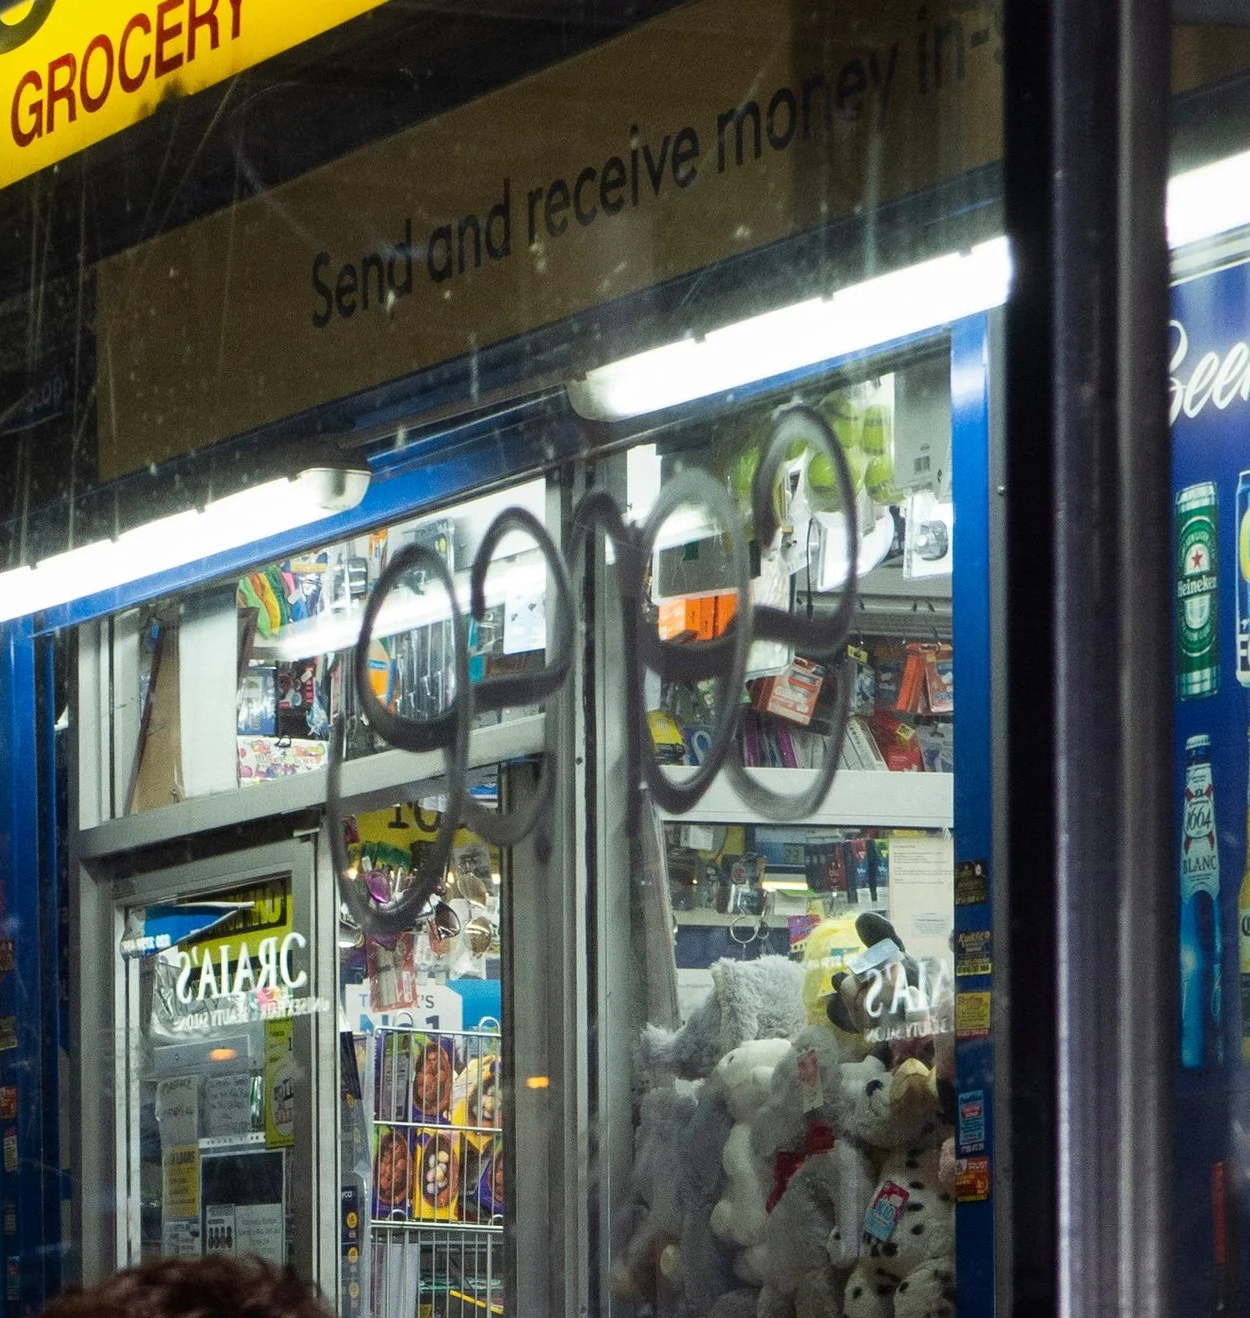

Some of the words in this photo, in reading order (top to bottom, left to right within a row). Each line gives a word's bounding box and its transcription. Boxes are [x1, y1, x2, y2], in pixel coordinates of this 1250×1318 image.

[10, 0, 242, 147] GROCERY
[311, 219, 412, 328] Send
[427, 178, 510, 284] and
[527, 125, 700, 247] receive
[717, 44, 897, 174] money
[1177, 572, 1217, 598] Heineken
[1187, 804, 1213, 832] 1664
[1182, 856, 1217, 875] BLANC
